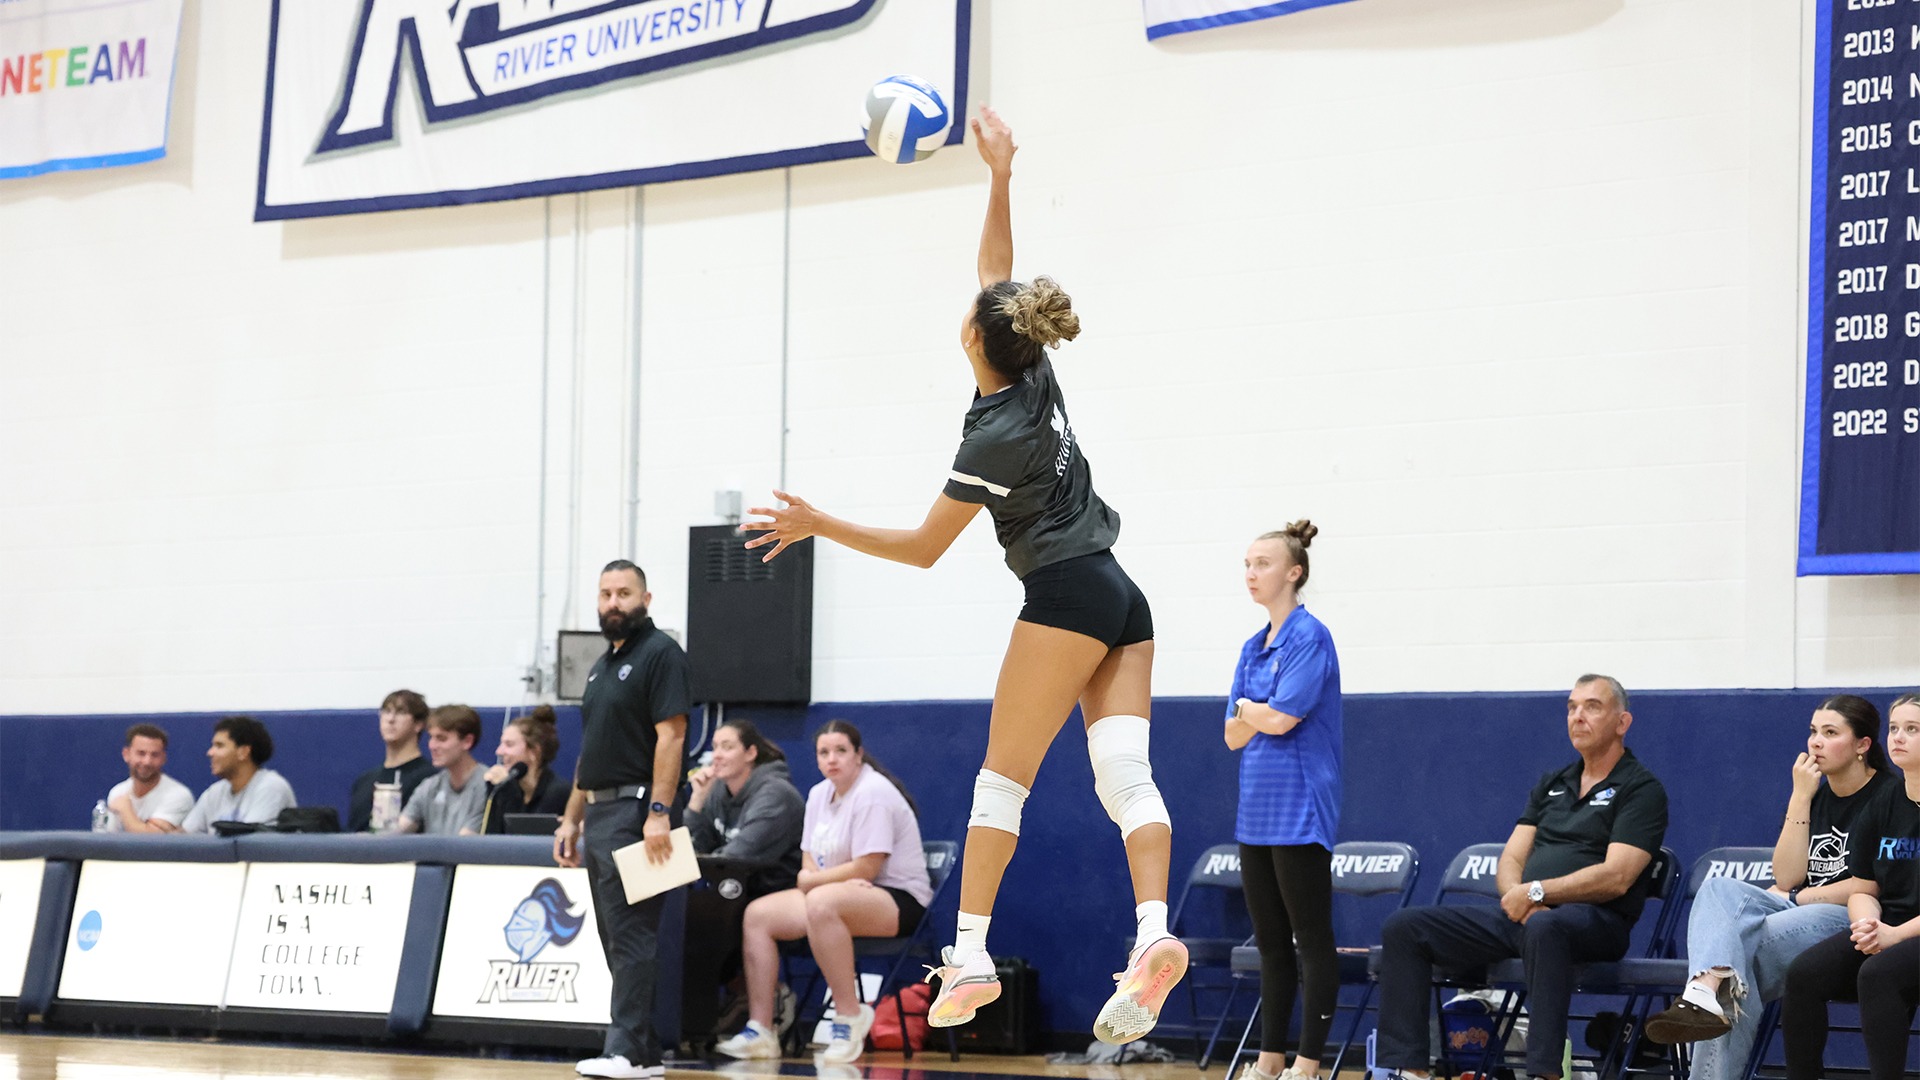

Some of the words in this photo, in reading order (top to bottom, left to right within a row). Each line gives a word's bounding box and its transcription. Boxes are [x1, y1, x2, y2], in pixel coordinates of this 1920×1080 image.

[494, 33, 577, 82] RIVIER
[586, 0, 748, 58] UNIVERSITY
[1843, 27, 1895, 58] 2013
[1842, 75, 1893, 105] 2014
[1841, 122, 1892, 152] 2015
[1840, 170, 1890, 200] 2017
[1839, 217, 1889, 247] 2017
[1838, 265, 1888, 294] 2017
[1835, 313, 1888, 342] 2018
[1833, 361, 1888, 389] 2022
[1833, 409, 1887, 437] 2022
[1204, 854, 1241, 875] RIV
[1331, 854, 1404, 878] RIVIER
[1703, 860, 1776, 881] RIVIE
[267, 914, 288, 934] IS
[300, 914, 311, 934] A
[476, 959, 580, 1004] RIVIER
